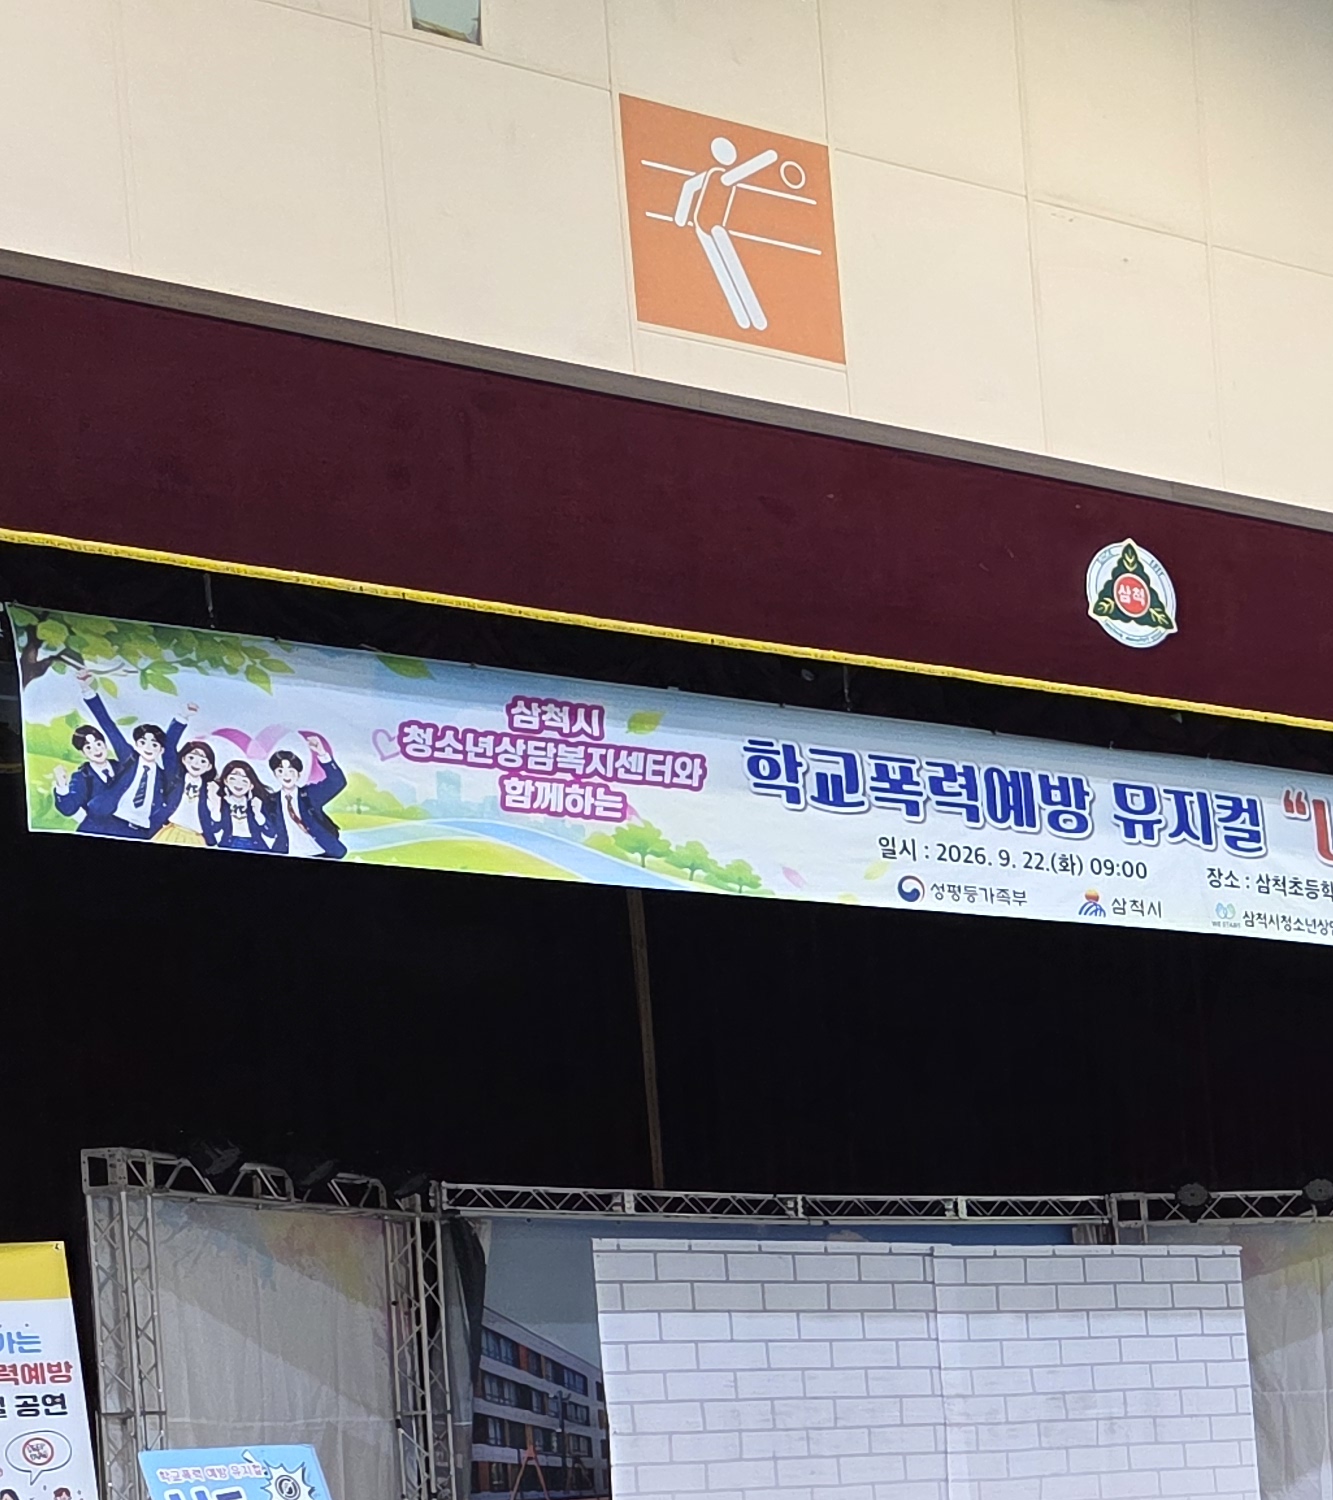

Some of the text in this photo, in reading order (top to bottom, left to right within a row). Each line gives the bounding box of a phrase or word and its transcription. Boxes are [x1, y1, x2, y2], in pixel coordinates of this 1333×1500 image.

[511, 700, 601, 736] 삼척시
[402, 724, 702, 787] 청소년상담복지센터와
[503, 777, 623, 818] 함께하는
[743, 738, 1090, 834] 학교폭력예방
[1112, 782, 1264, 852] 뮤지컬
[878, 836, 917, 861] 일시
[1090, 857, 1148, 879] 09:00
[930, 882, 1028, 907] 성평등가족부
[1206, 867, 1241, 888] 장소
[1111, 897, 1163, 918] 삼척시
[14, 1393, 68, 1417] 공연
